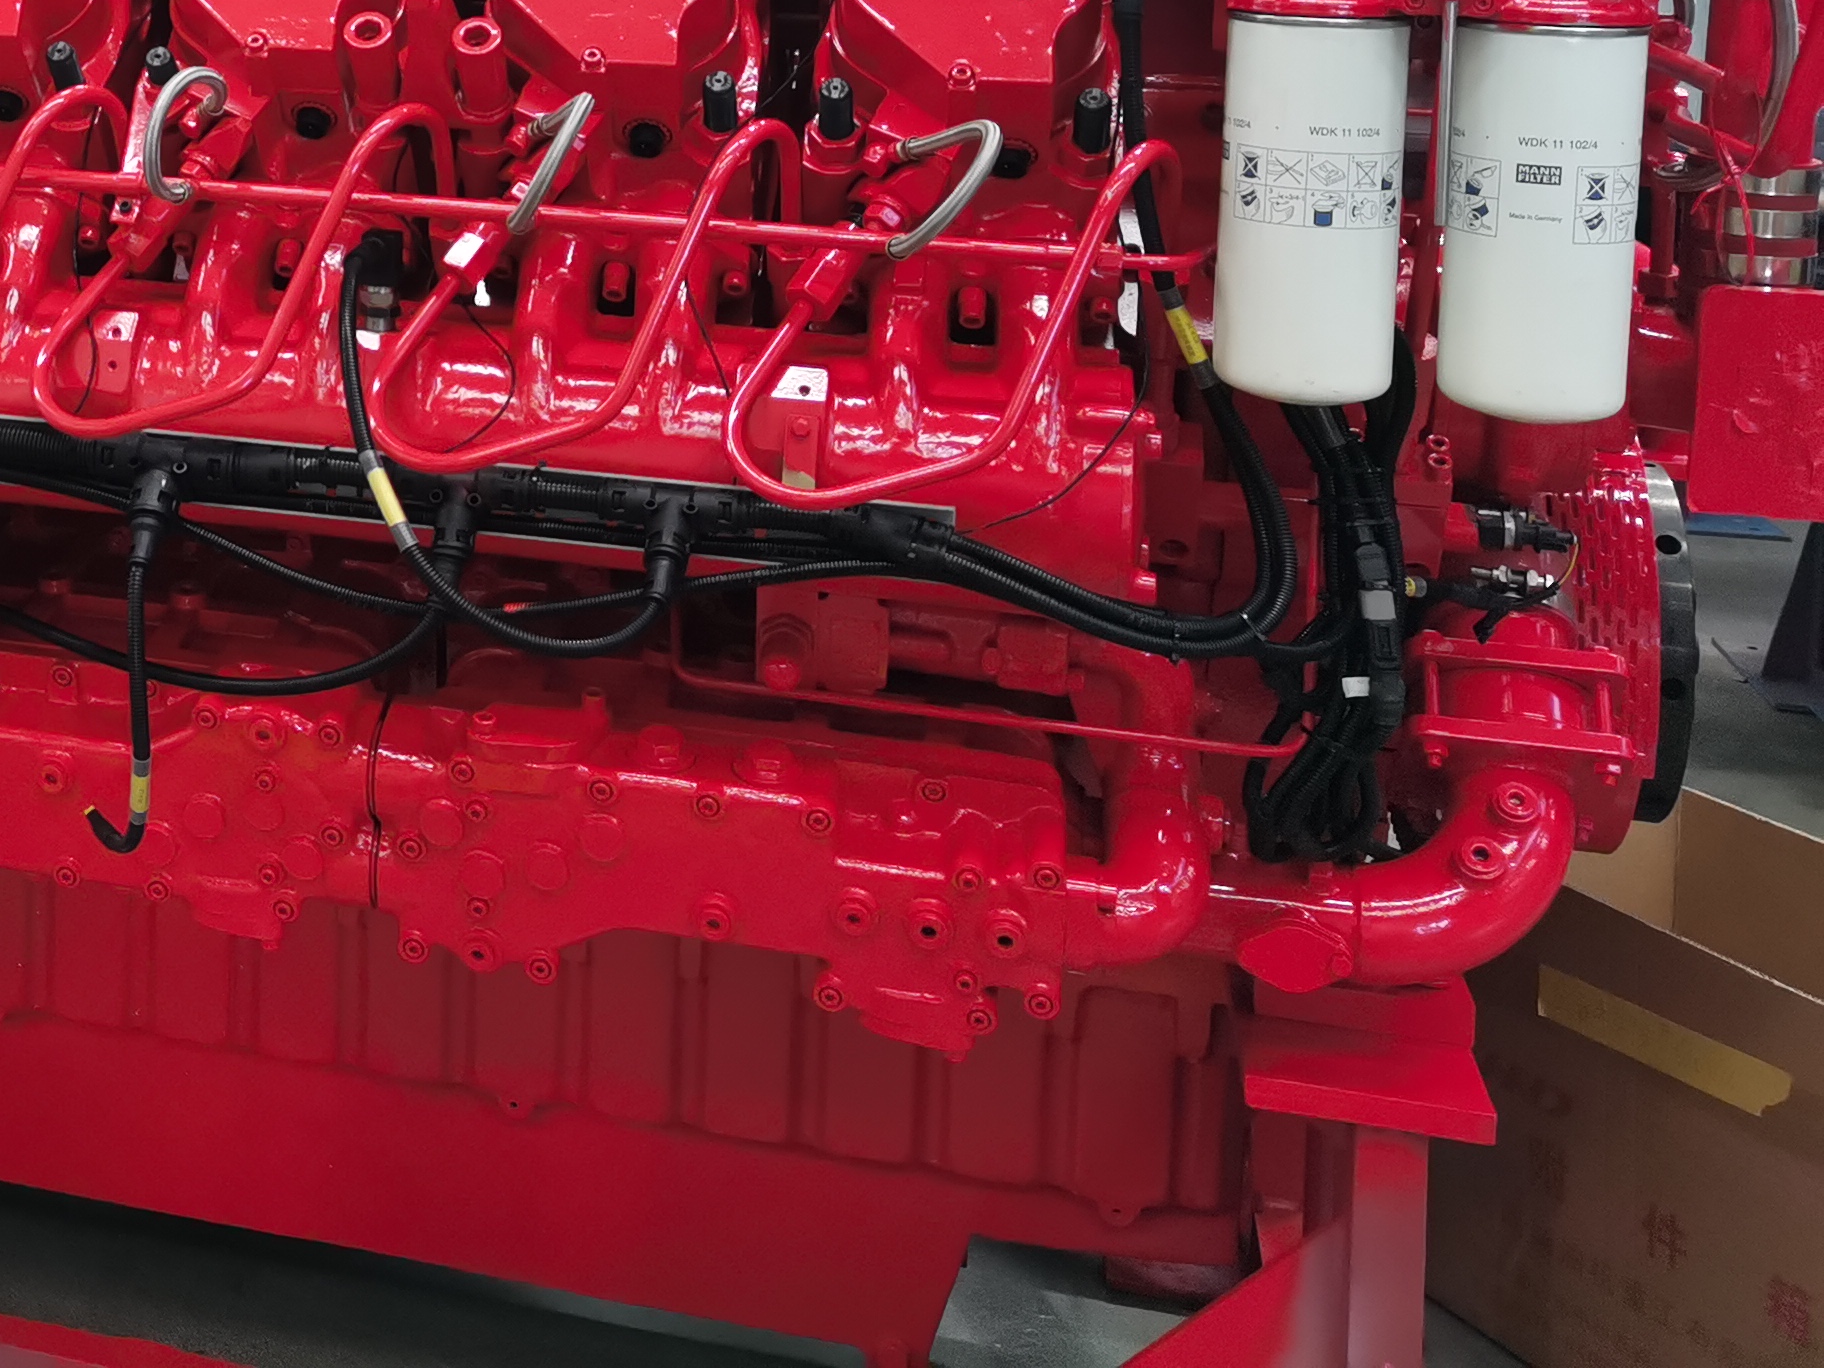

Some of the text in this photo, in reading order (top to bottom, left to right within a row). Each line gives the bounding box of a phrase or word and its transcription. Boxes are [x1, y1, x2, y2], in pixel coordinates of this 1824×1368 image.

[1308, 125, 1381, 138] WDK 11 102/4
[1517, 136, 1599, 150] WDK 11 102/4
[1518, 165, 1561, 177] MANN
[1517, 173, 1560, 185] FILTER
